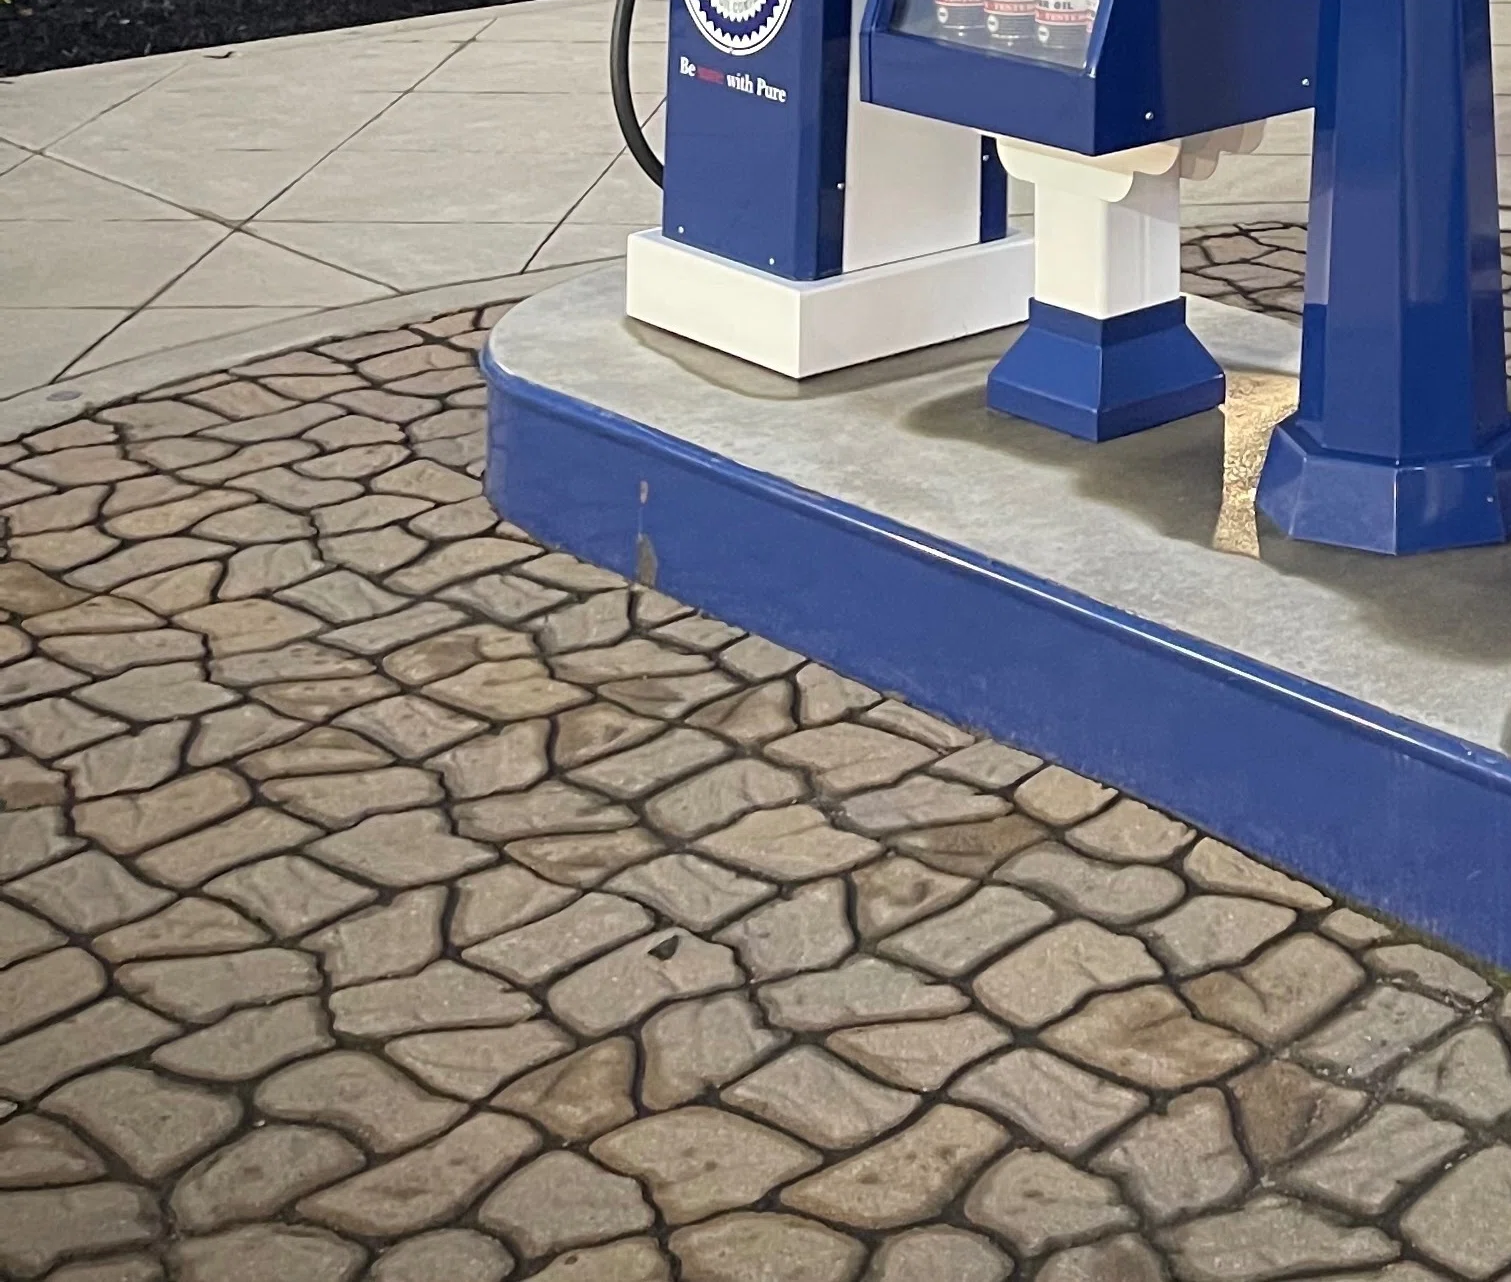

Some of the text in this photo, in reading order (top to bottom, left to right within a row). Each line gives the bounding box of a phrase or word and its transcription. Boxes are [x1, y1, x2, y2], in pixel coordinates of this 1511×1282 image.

[1054, 1, 1073, 10] OIL
[680, 56, 696, 77] Be
[727, 72, 754, 93] with
[757, 77, 786, 103] Pure
